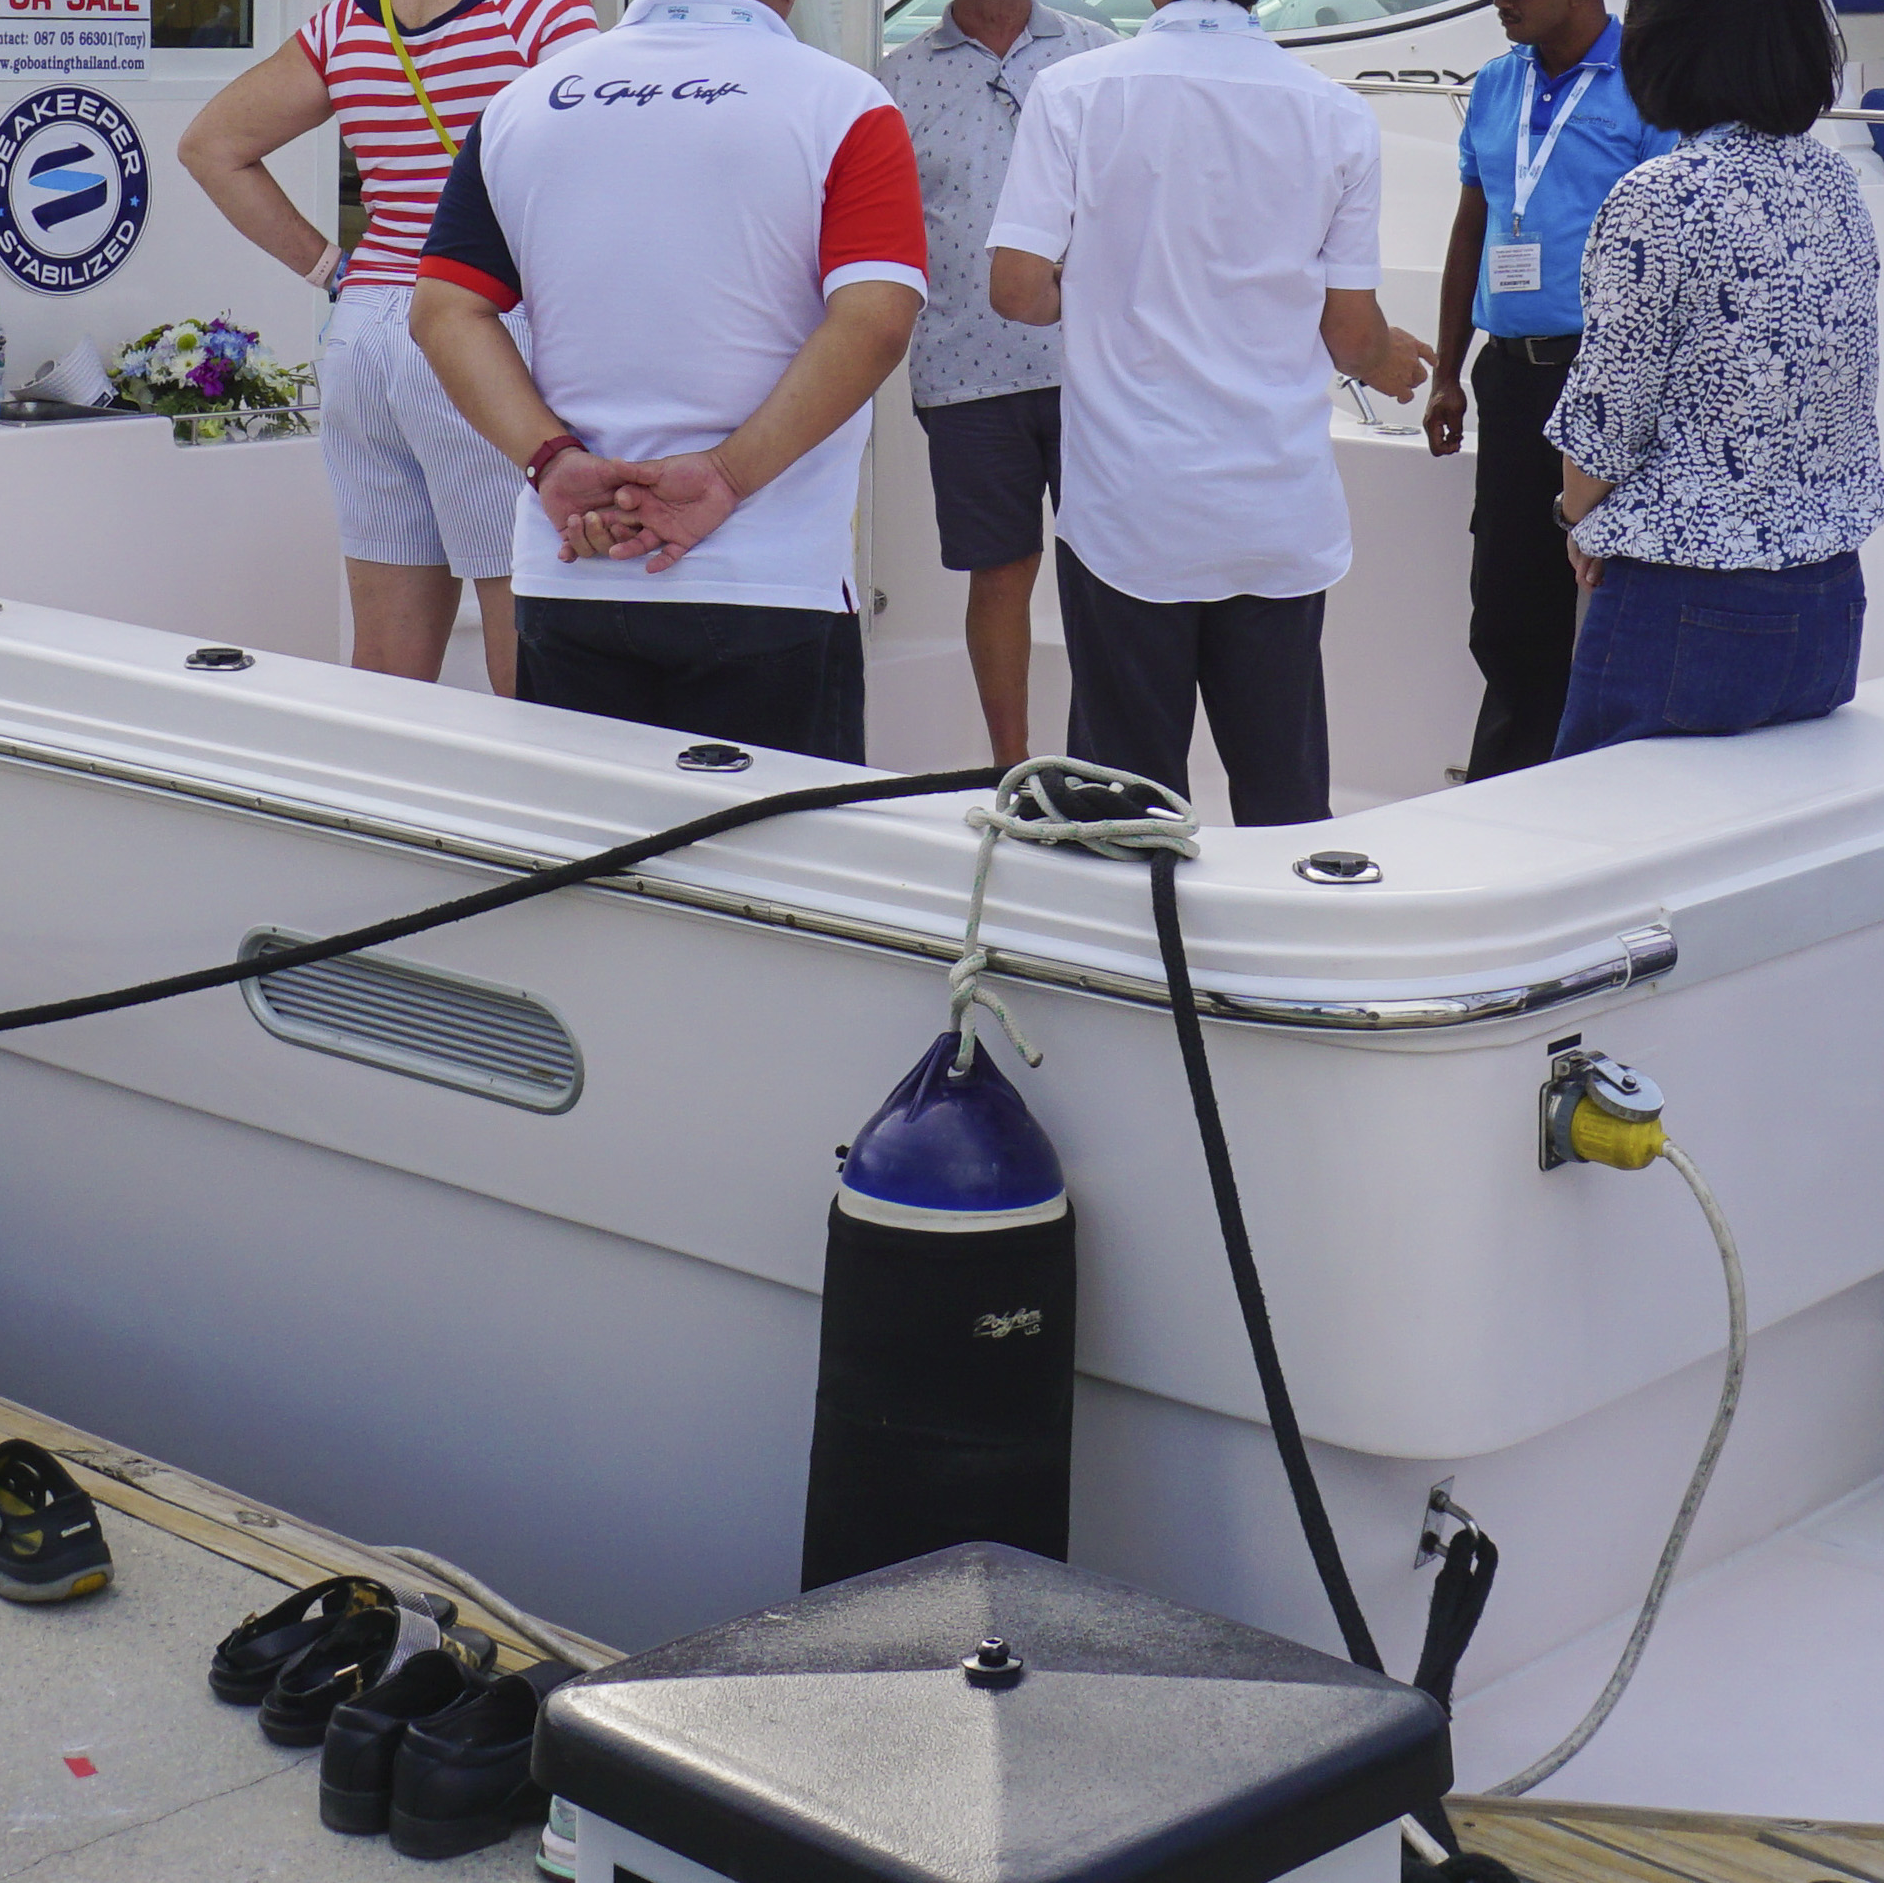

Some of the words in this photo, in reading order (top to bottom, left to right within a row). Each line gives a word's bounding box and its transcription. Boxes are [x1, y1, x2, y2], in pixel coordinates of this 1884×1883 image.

[33, 31, 56, 46] 087
[60, 31, 75, 46] 05
[594, 80, 664, 106] Gulf
[672, 78, 748, 105] Craft
